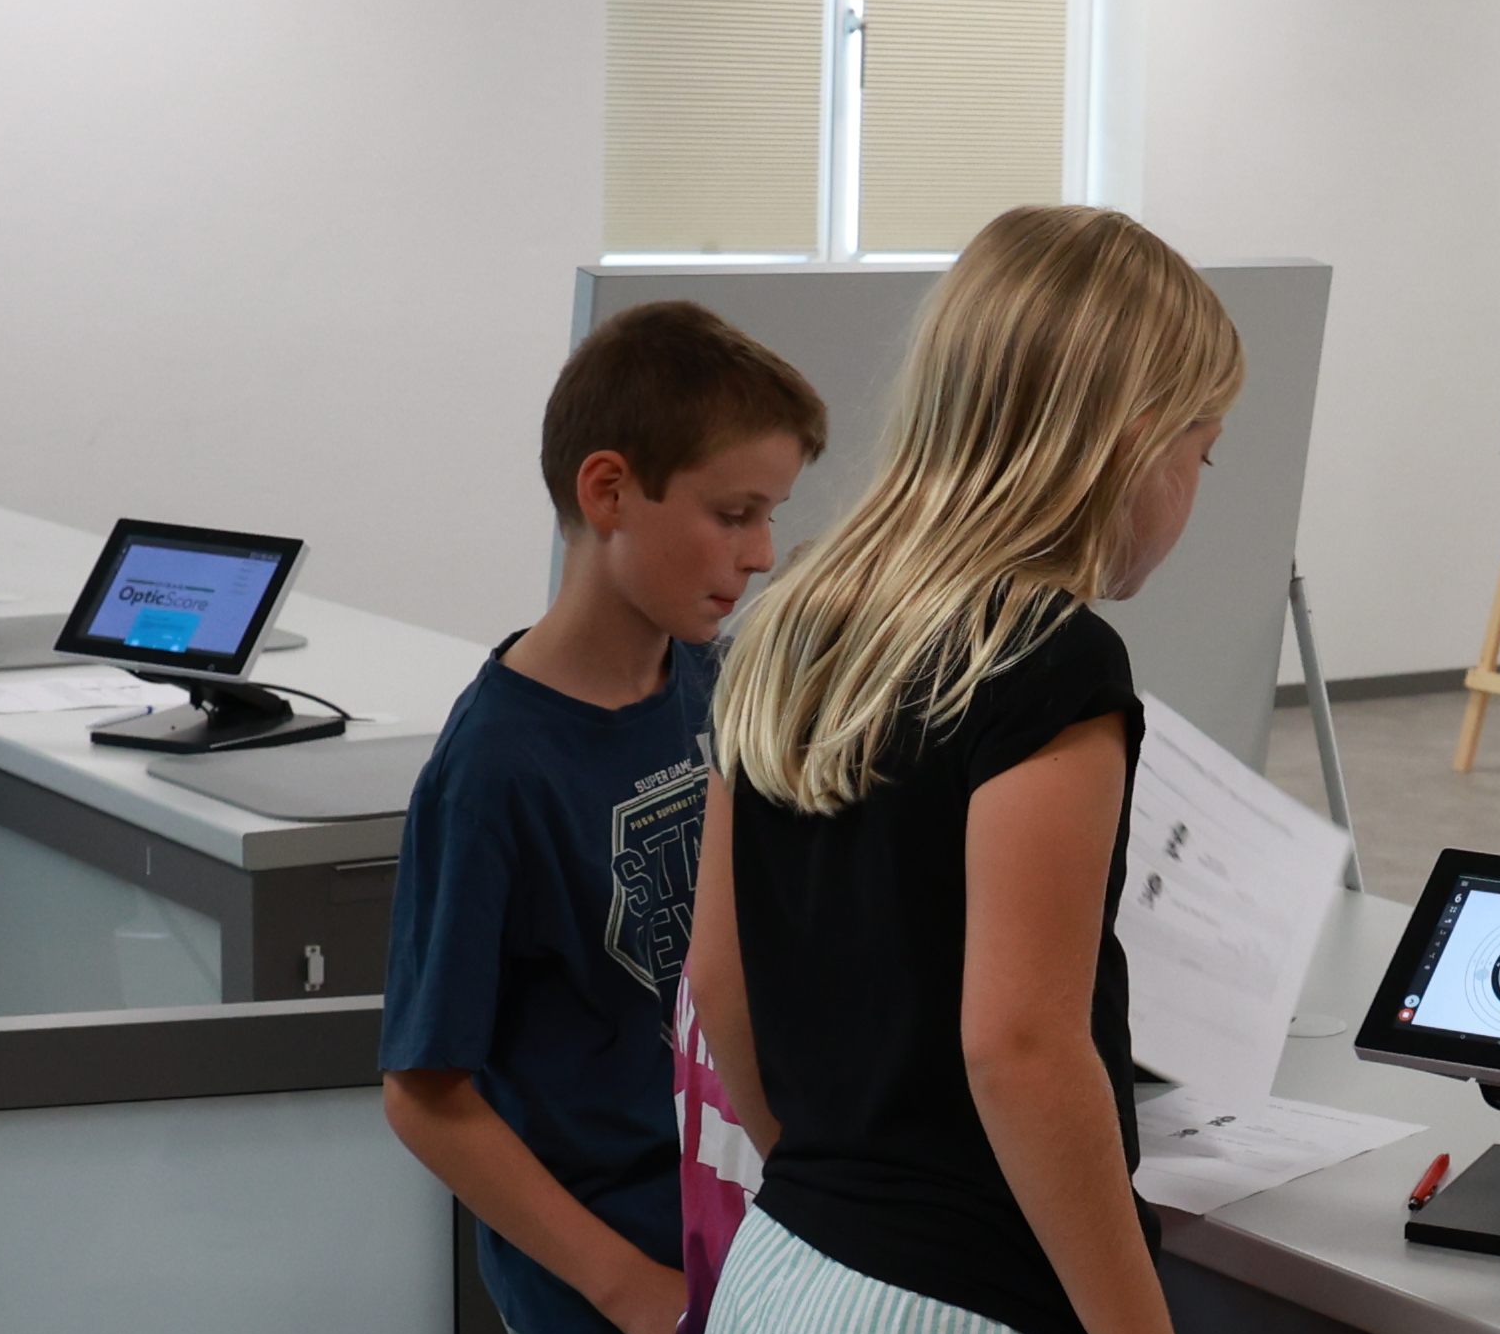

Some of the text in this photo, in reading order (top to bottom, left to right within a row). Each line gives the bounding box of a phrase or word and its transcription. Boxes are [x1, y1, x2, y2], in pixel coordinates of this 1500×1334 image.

[119, 585, 209, 612] OpticScore
[633, 769, 669, 794] SUPER
[1454, 893, 1463, 903] 6
